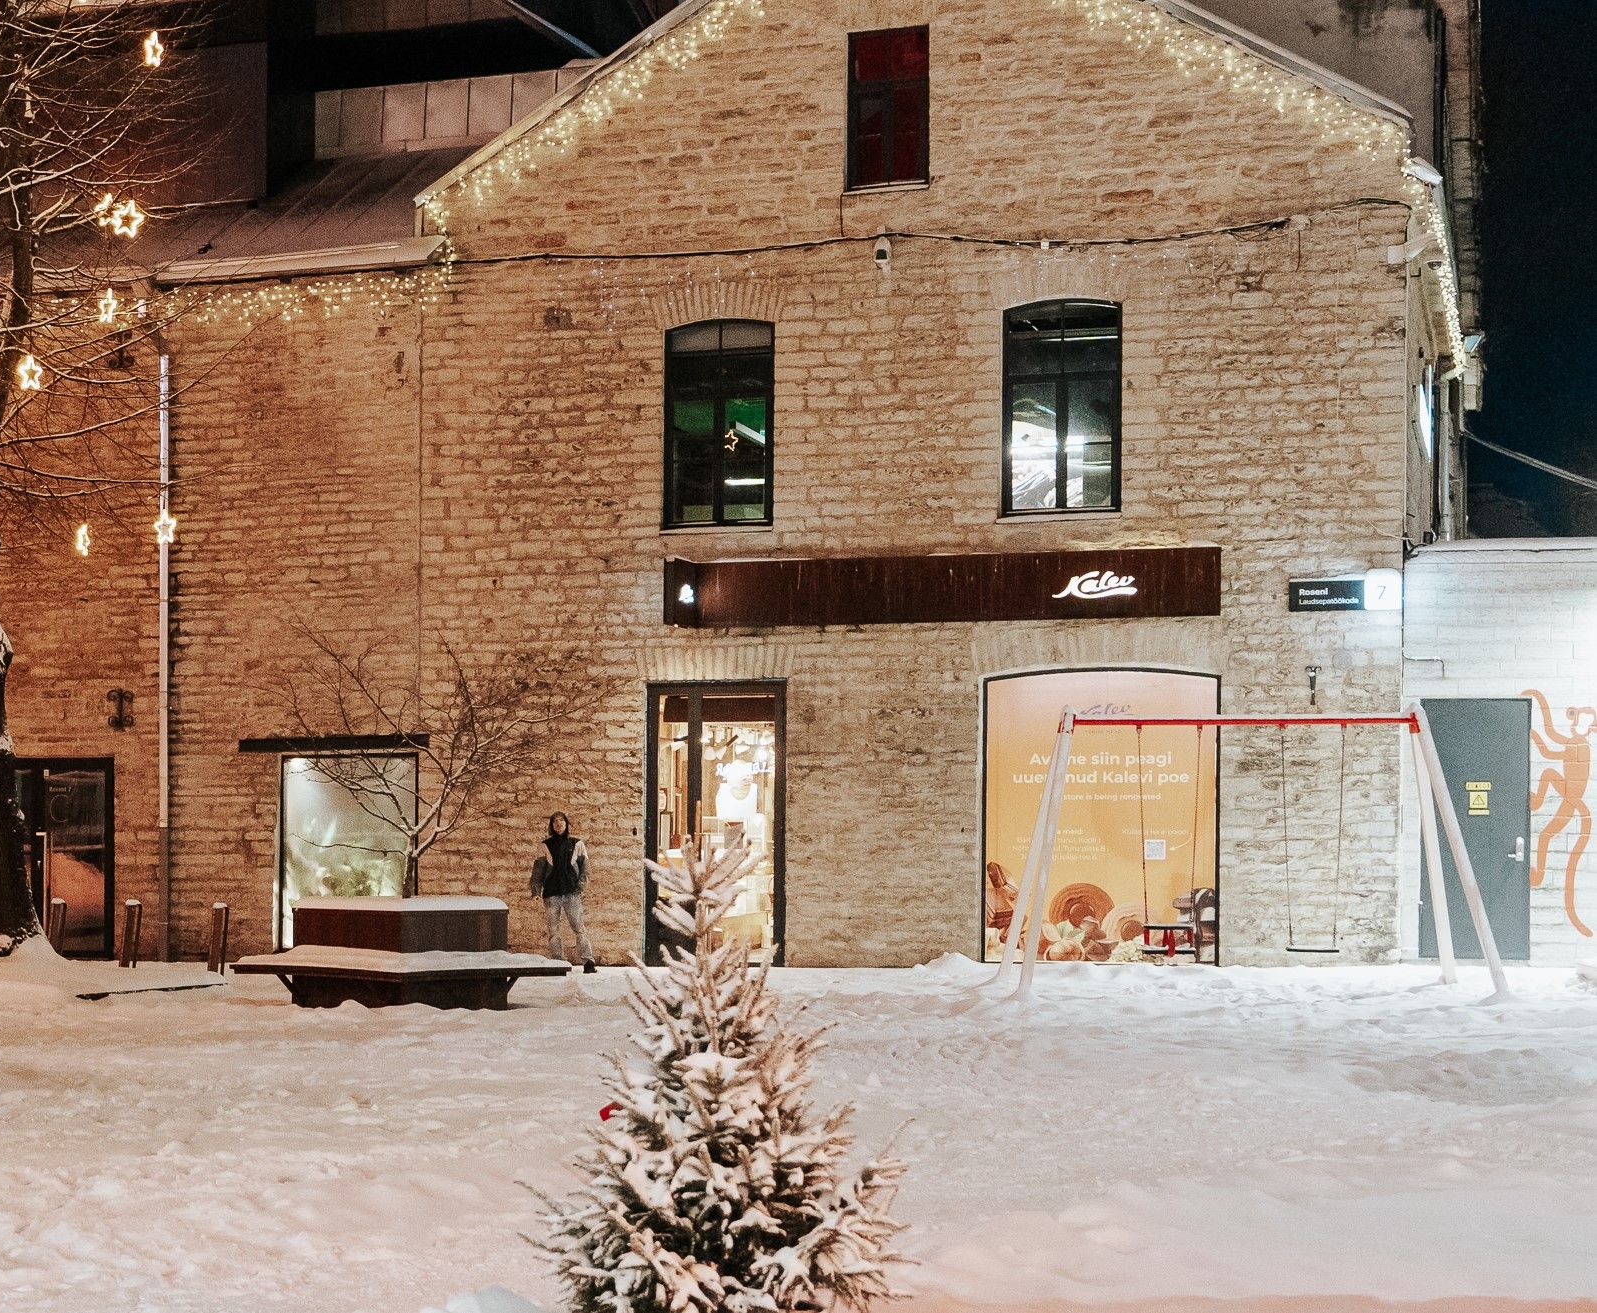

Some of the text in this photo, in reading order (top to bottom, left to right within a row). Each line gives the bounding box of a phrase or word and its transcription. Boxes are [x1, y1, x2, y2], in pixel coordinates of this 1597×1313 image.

[1052, 571, 1138, 599] Kalev
[1299, 588, 1329, 596] Roseni
[1378, 586, 1386, 600] 7
[1091, 752, 1120, 765] siin
[1125, 751, 1172, 767] peagi
[1103, 769, 1153, 784] Kalevi
[1158, 773, 1190, 786] poe
[1094, 793, 1118, 801] being
